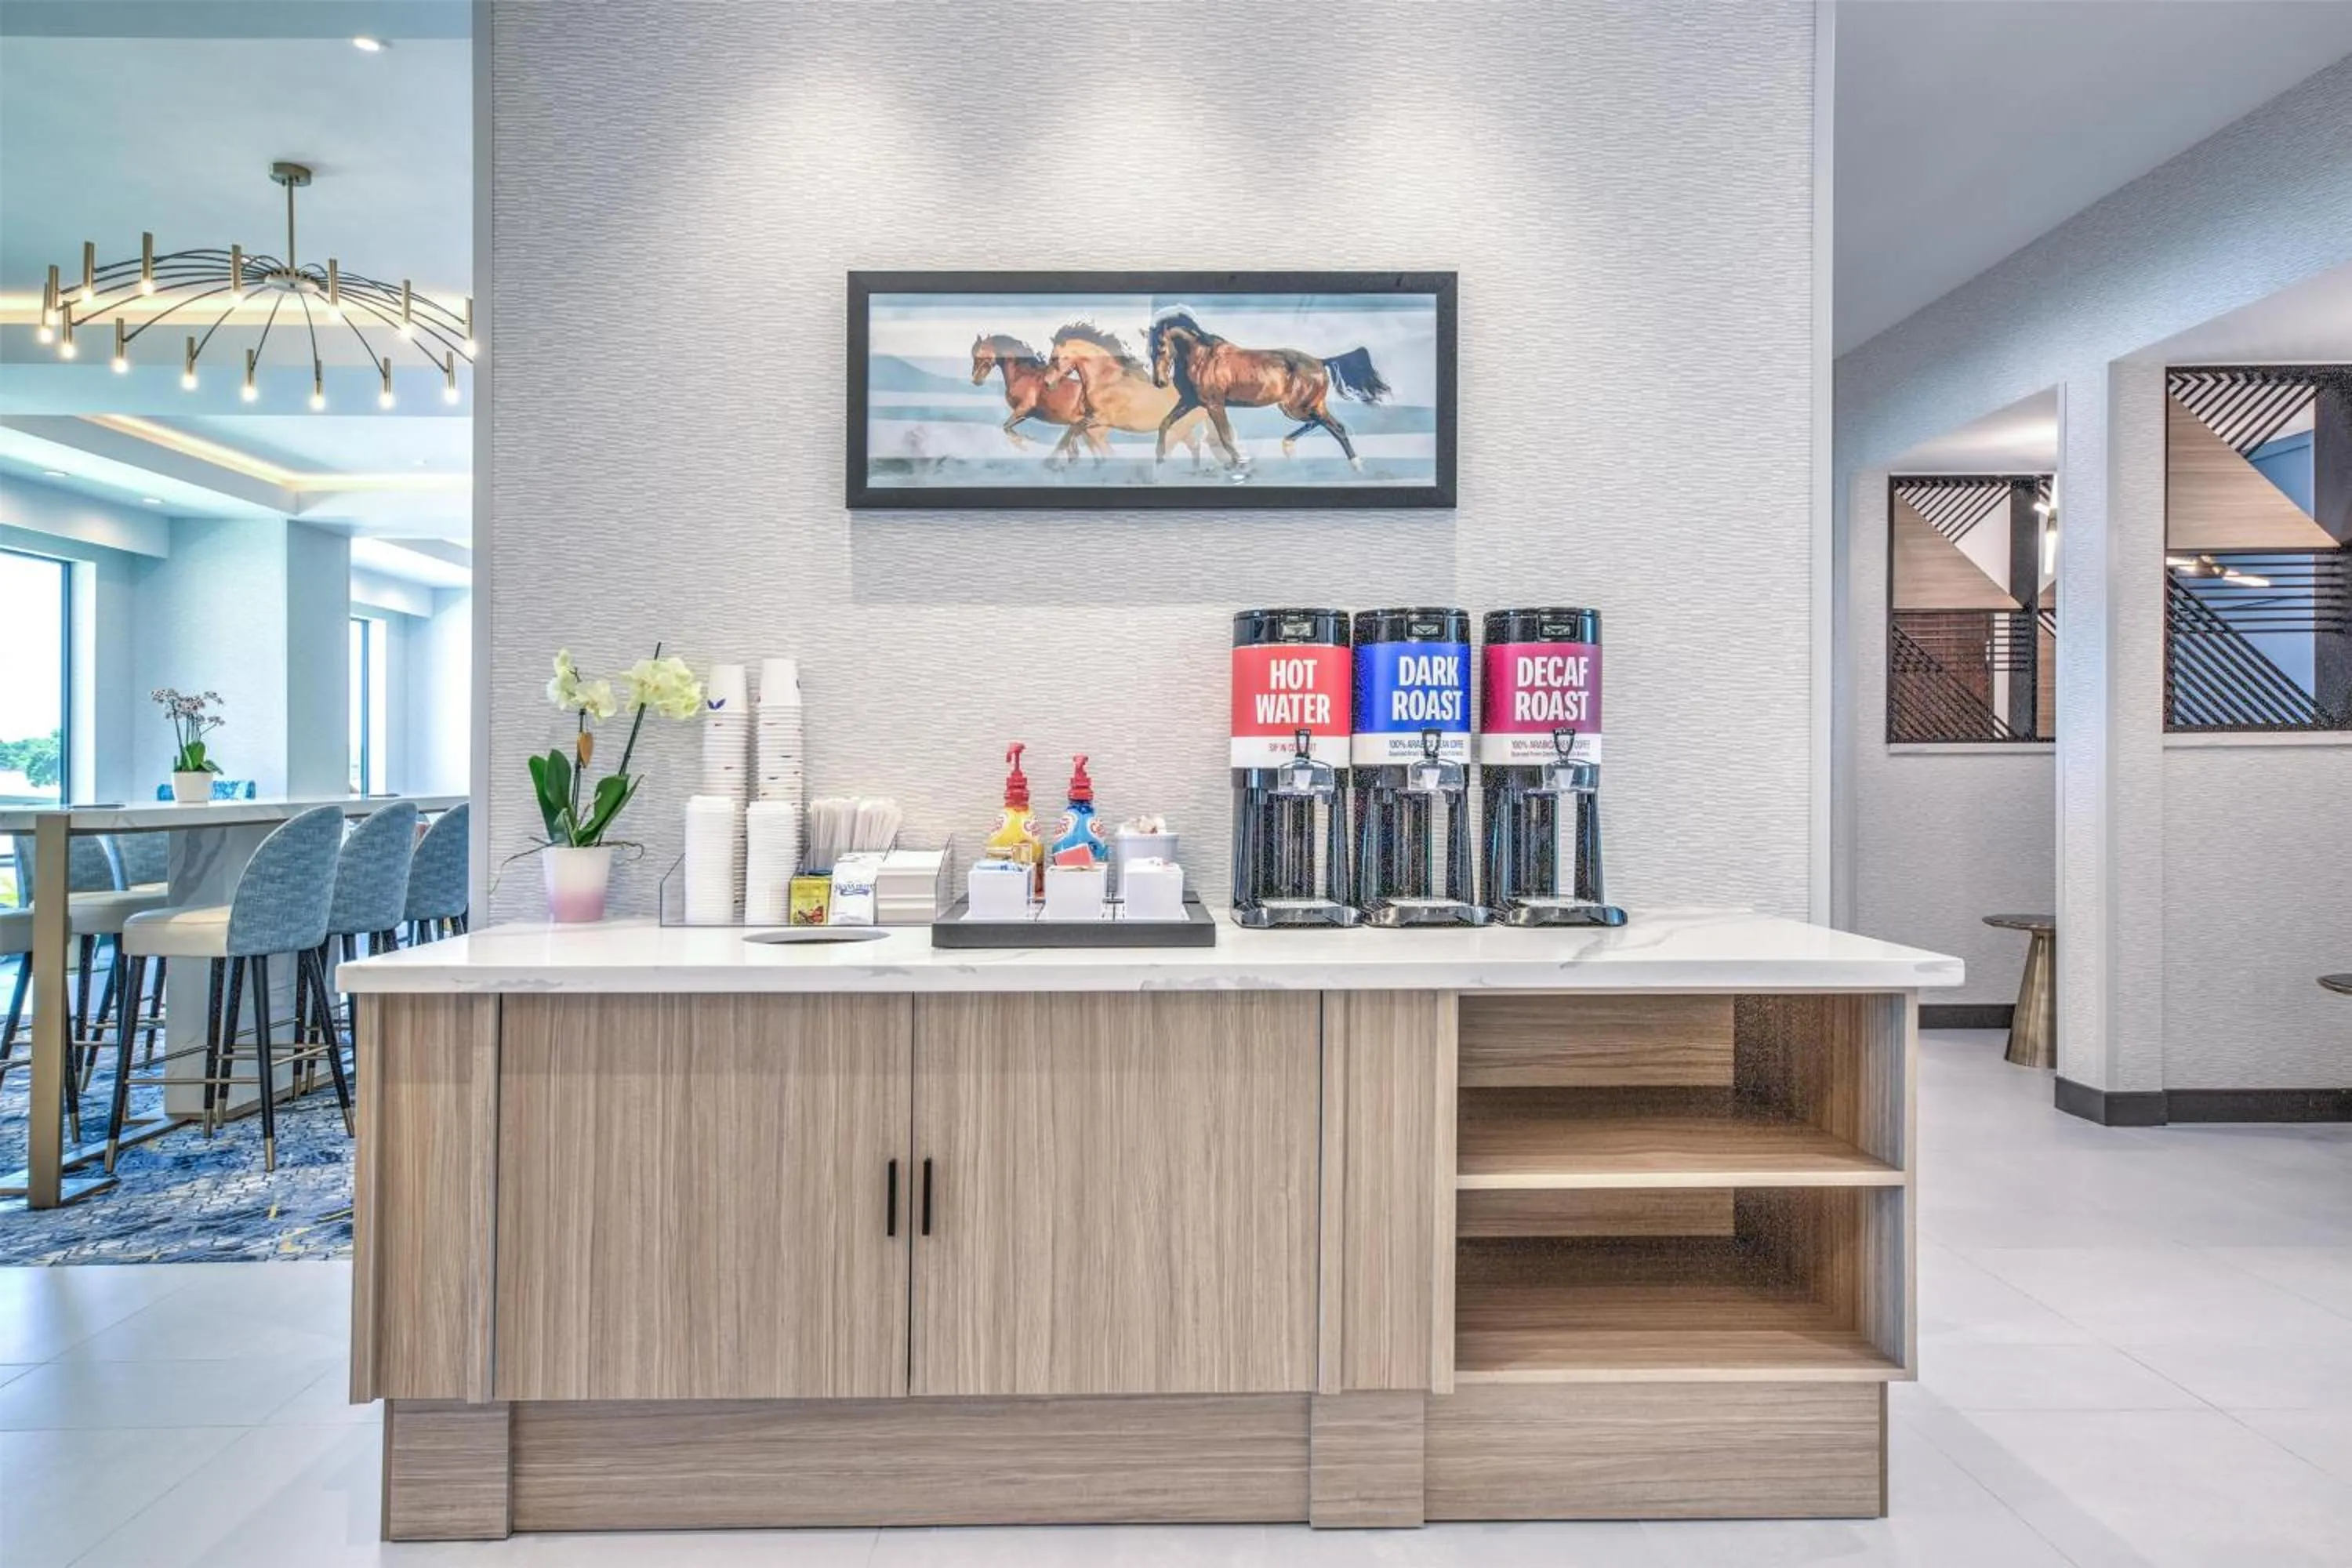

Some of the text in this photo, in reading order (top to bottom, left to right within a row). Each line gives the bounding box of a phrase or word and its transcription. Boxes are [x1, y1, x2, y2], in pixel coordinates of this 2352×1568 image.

[1269, 659, 1318, 690] HOT
[1399, 655, 1459, 686] DARK
[1517, 656, 1589, 688] DECAF
[1255, 693, 1330, 724] WATER
[1392, 689, 1462, 720] ROAST
[1515, 691, 1589, 721] ROAST
